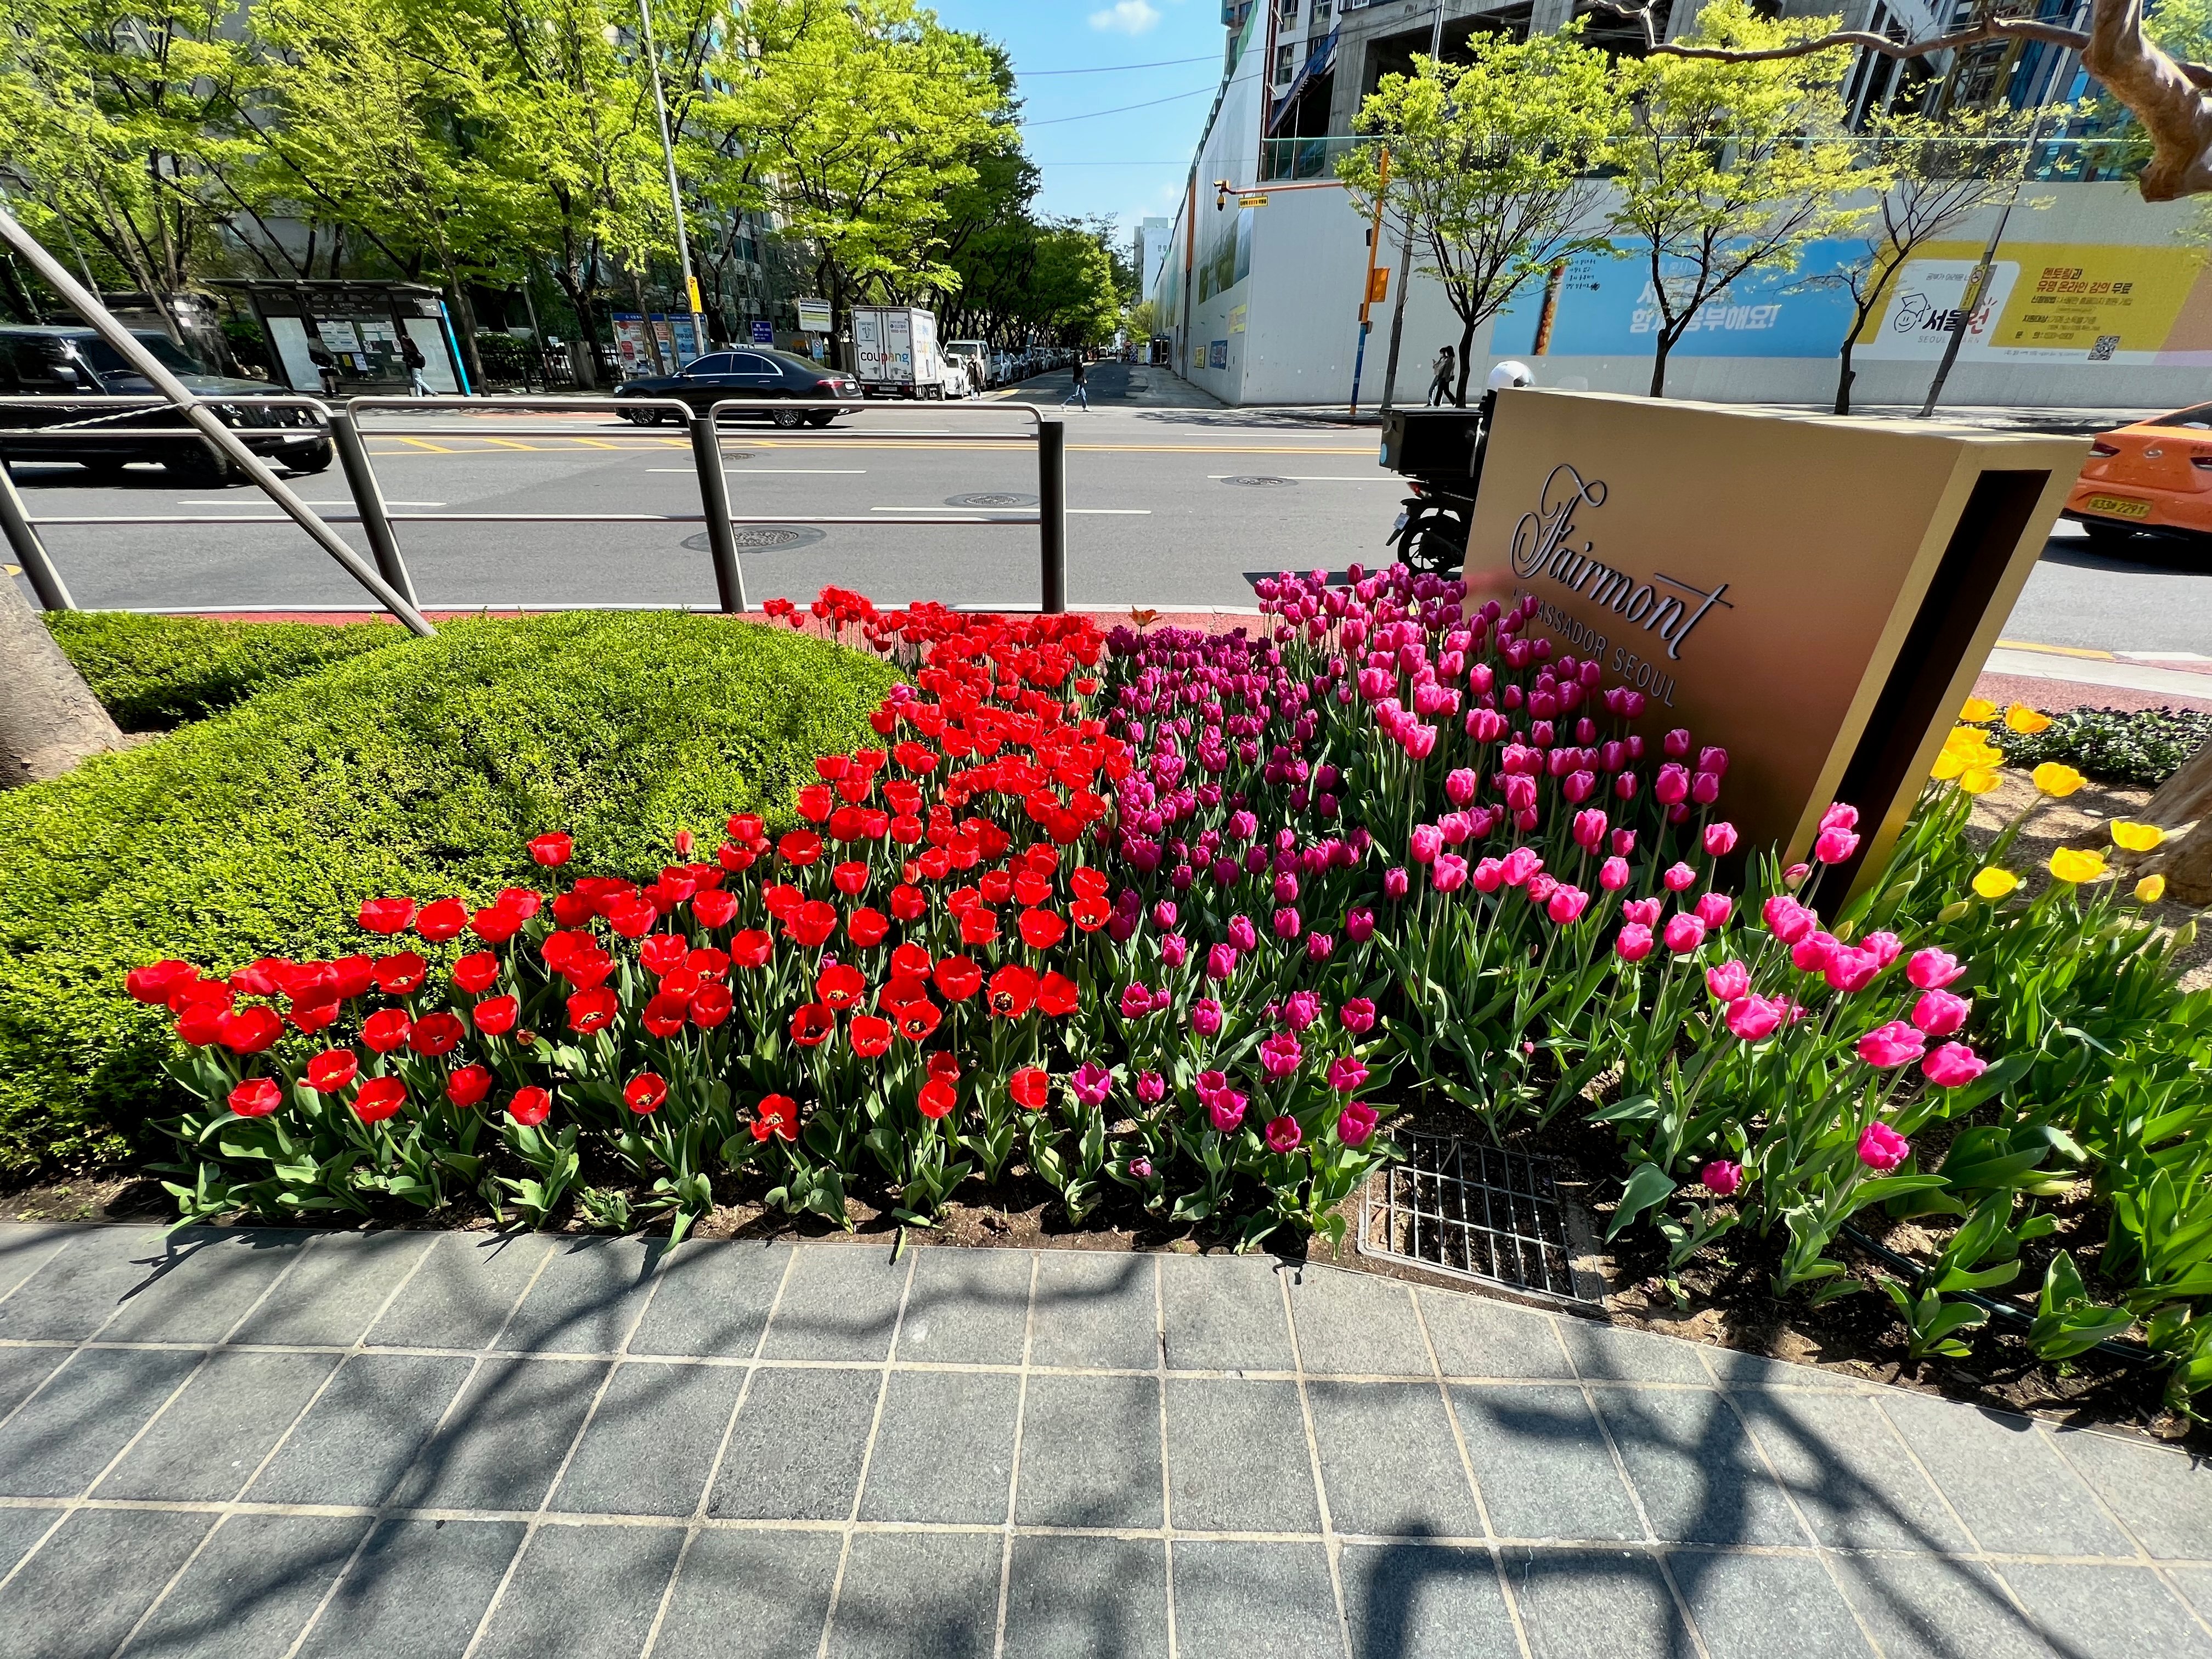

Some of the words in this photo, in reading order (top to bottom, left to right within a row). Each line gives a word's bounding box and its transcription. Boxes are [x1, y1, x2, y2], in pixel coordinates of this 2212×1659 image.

[2041, 267, 2083, 280] 멘토링과
[2036, 280, 2058, 292] 유명
[2057, 281, 2088, 294] 온라인
[2089, 282, 2112, 294] 강의
[2111, 283, 2134, 294] 무료
[1918, 335, 1946, 343] SEOUL
[860, 352, 910, 366] coupang
[1510, 463, 1734, 660] Fairmont
[1612, 647, 1676, 708] SEOUL
